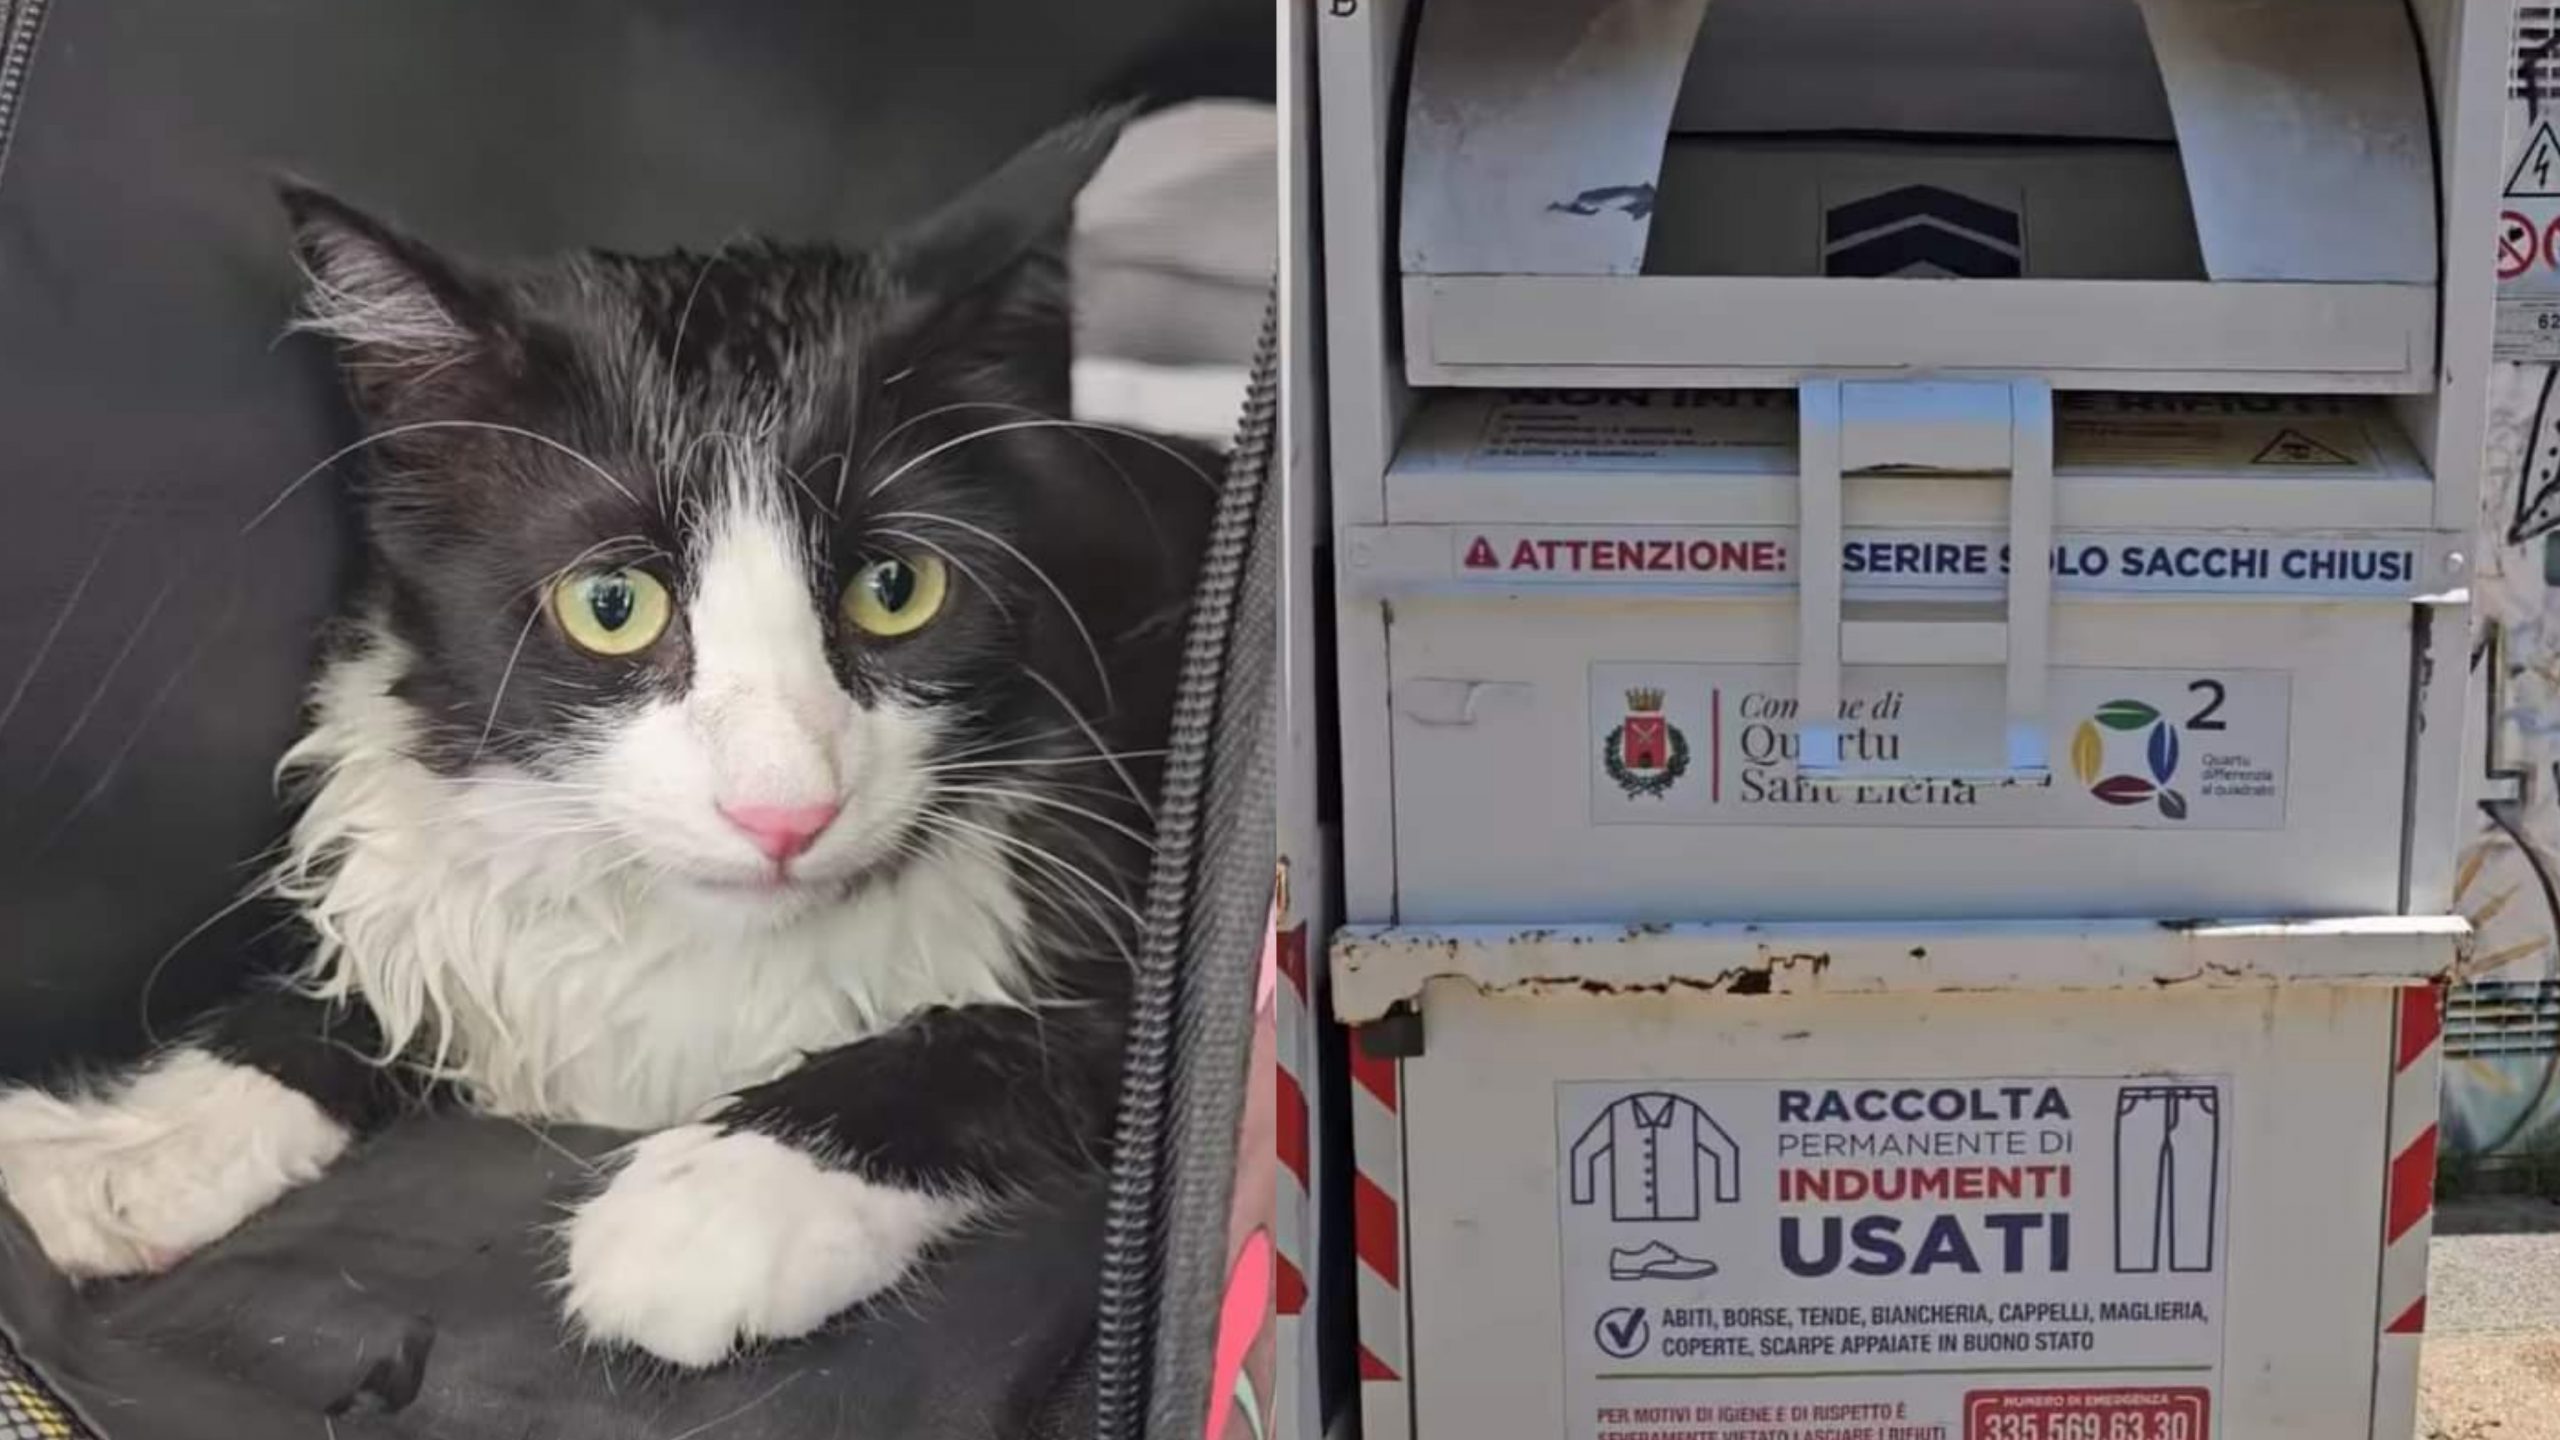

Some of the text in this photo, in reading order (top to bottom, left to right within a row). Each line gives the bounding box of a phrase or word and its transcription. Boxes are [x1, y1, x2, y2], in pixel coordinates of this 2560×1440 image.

[1510, 540, 1787, 573] ATTENZIONE:
[1841, 542, 1988, 575] SERIRE
[2121, 546, 2270, 580] SACCHI
[2281, 549, 2414, 582] CHIUSI
[1871, 691, 1904, 721] di
[2185, 678, 2227, 731] 2
[1739, 723, 1900, 767] Qurtu
[1778, 1085, 2071, 1123] RACCOLTA
[1778, 1130, 2073, 1158] PERMANENTE DI
[1778, 1165, 2072, 1202] INDUMENTI
[1778, 1212, 2071, 1278] USATI
[1661, 1301, 2209, 1331] ABITI, BORSE, TENDE, BIANCHERIA, CAPPELLI, MAGLIERIA,
[1661, 1331, 2095, 1359] COPERTE, SCARPE APPAIATE IN BUONO STATO
[1597, 1407, 1629, 1424] PER
[1634, 1406, 1691, 1424] MOTIVI
[1695, 1406, 1714, 1423] DI
[1718, 1405, 1772, 1423] IGIENE
[1791, 1405, 1808, 1421] DI
[1813, 1403, 1892, 1421] RISPETTO
